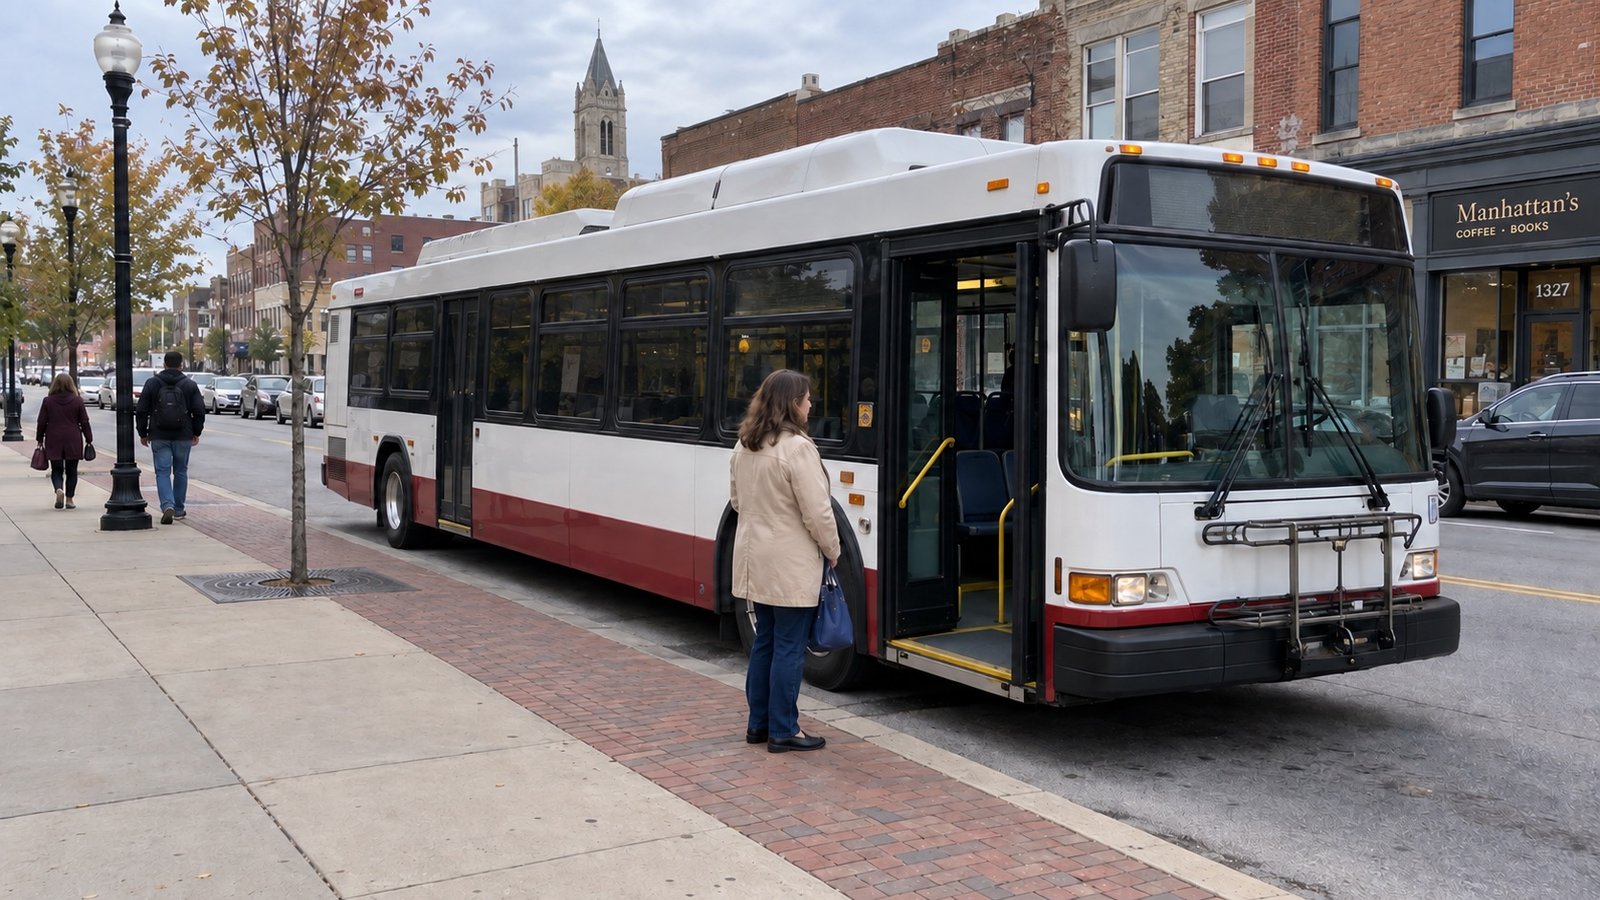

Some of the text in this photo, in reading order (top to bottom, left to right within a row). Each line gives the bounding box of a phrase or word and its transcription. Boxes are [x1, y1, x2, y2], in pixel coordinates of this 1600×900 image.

[1456, 192, 1579, 224] Manhattan's
[1456, 221, 1549, 239] COFFEE BOOKS
[1535, 282, 1570, 298] 1327
